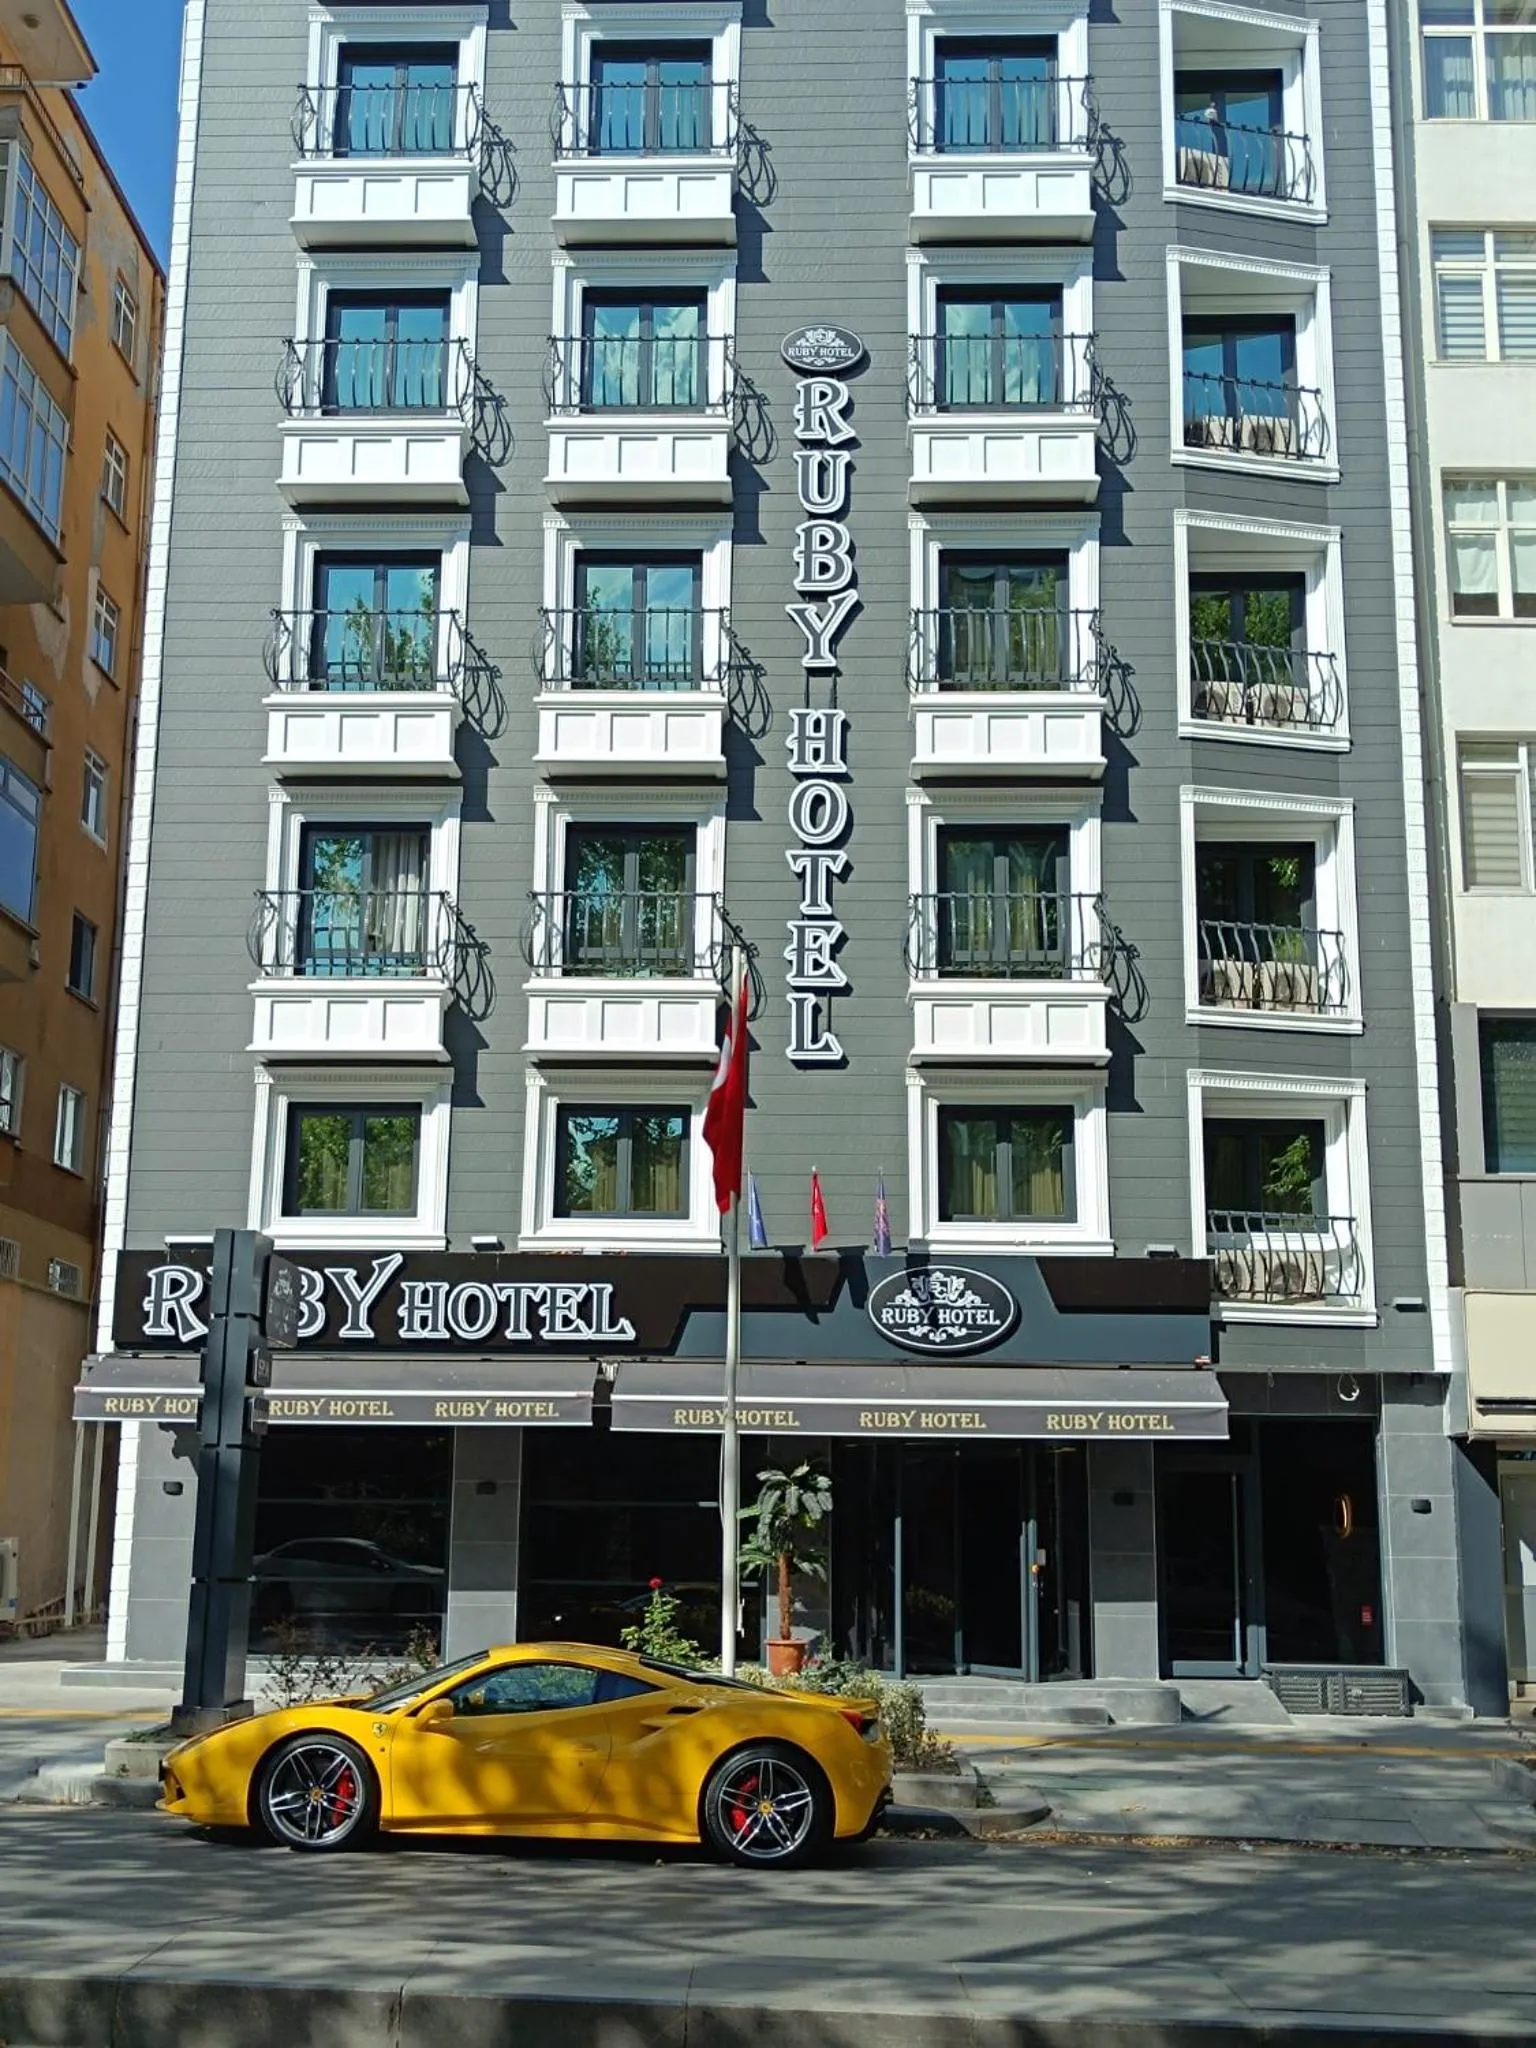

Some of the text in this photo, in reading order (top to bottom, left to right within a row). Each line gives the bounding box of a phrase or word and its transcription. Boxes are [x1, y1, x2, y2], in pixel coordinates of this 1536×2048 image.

[787, 346, 854, 357] RUBY HOTEL
[785, 377, 858, 668] RUBY
[784, 709, 849, 1060] HOTEL
[143, 1253, 403, 1343] RBY
[397, 1282, 637, 1340] HOTEL
[881, 1306, 1001, 1325] RUBY HOTEL
[105, 1396, 199, 1414] RUBY HOT
[269, 1398, 395, 1416] RUBY HOTEL
[435, 1399, 559, 1417] RUBY HOTEL
[735, 1410, 800, 1426] HOTEL
[859, 1410, 987, 1428] RUBY HOTEL
[1046, 1411, 1175, 1430] RUBY HOTEL
